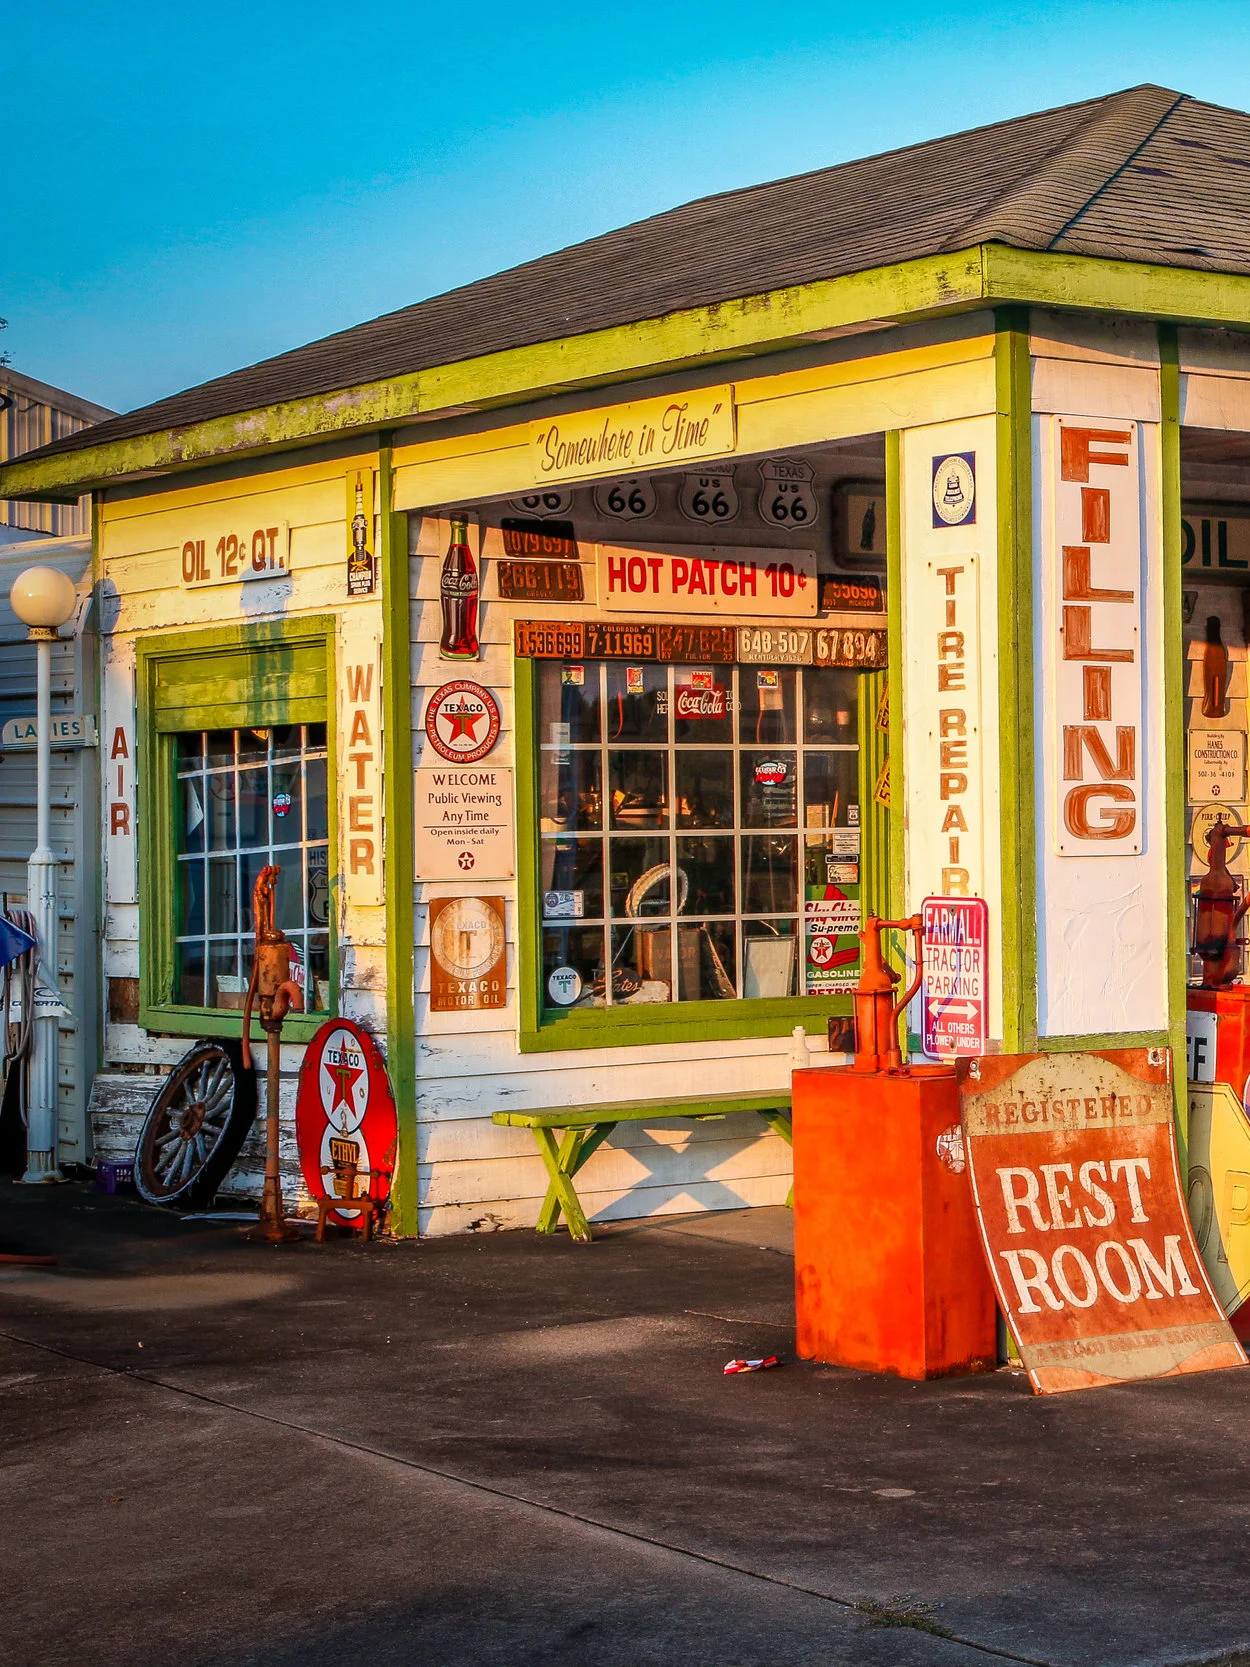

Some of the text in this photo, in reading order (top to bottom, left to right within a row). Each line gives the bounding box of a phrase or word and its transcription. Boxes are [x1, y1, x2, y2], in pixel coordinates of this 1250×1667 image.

[638, 424, 656, 455] in
[772, 464, 805, 479] TEXAS
[699, 478, 721, 488] US
[778, 483, 799, 493] US
[607, 486, 646, 514] 66
[692, 490, 729, 517] 66
[772, 496, 808, 522] 66
[181, 539, 211, 584] OIL
[607, 556, 664, 595] HOT
[671, 561, 758, 598] PATCH
[602, 625, 640, 633] COLORADO
[1060, 426, 1136, 841] FILLING
[741, 630, 809, 654] 648-507
[428, 683, 490, 723] THE TEXAS COMPANY
[443, 703, 483, 713] TEXACO
[14, 719, 82, 740] LAIES
[936, 566, 971, 897] TIRE REPAIR
[430, 728, 497, 760] PETROLEUM PRODUCTS
[1194, 749, 1231, 759] CONSTRUCTION
[1207, 740, 1224, 749] HANES
[346, 662, 376, 876] WATER
[432, 773, 497, 786] WELCOME
[110, 726, 131, 836] AIR
[428, 792, 502, 807] Public Viewing
[442, 809, 489, 825] Any Time
[430, 827, 500, 837] Open inside daily
[446, 837, 485, 846] Mon Sat
[925, 907, 981, 945] FARMALL
[926, 947, 980, 973] TRACTOR
[552, 973, 577, 981] TEXACO
[807, 969, 861, 980] GASOLINE
[437, 980, 500, 994] TEXACO
[927, 975, 979, 997] PARKING
[437, 994, 500, 1006] MOTOR OIL
[932, 1021, 975, 1035] ALL OTHERS
[956, 1036, 981, 1049] UNDER
[327, 1049, 360, 1067] TEXACO
[984, 1094, 1153, 1127] REGISTERED
[331, 1140, 359, 1165] ETHYL
[995, 1156, 1153, 1234] REST
[1000, 1233, 1201, 1316] ROOM
